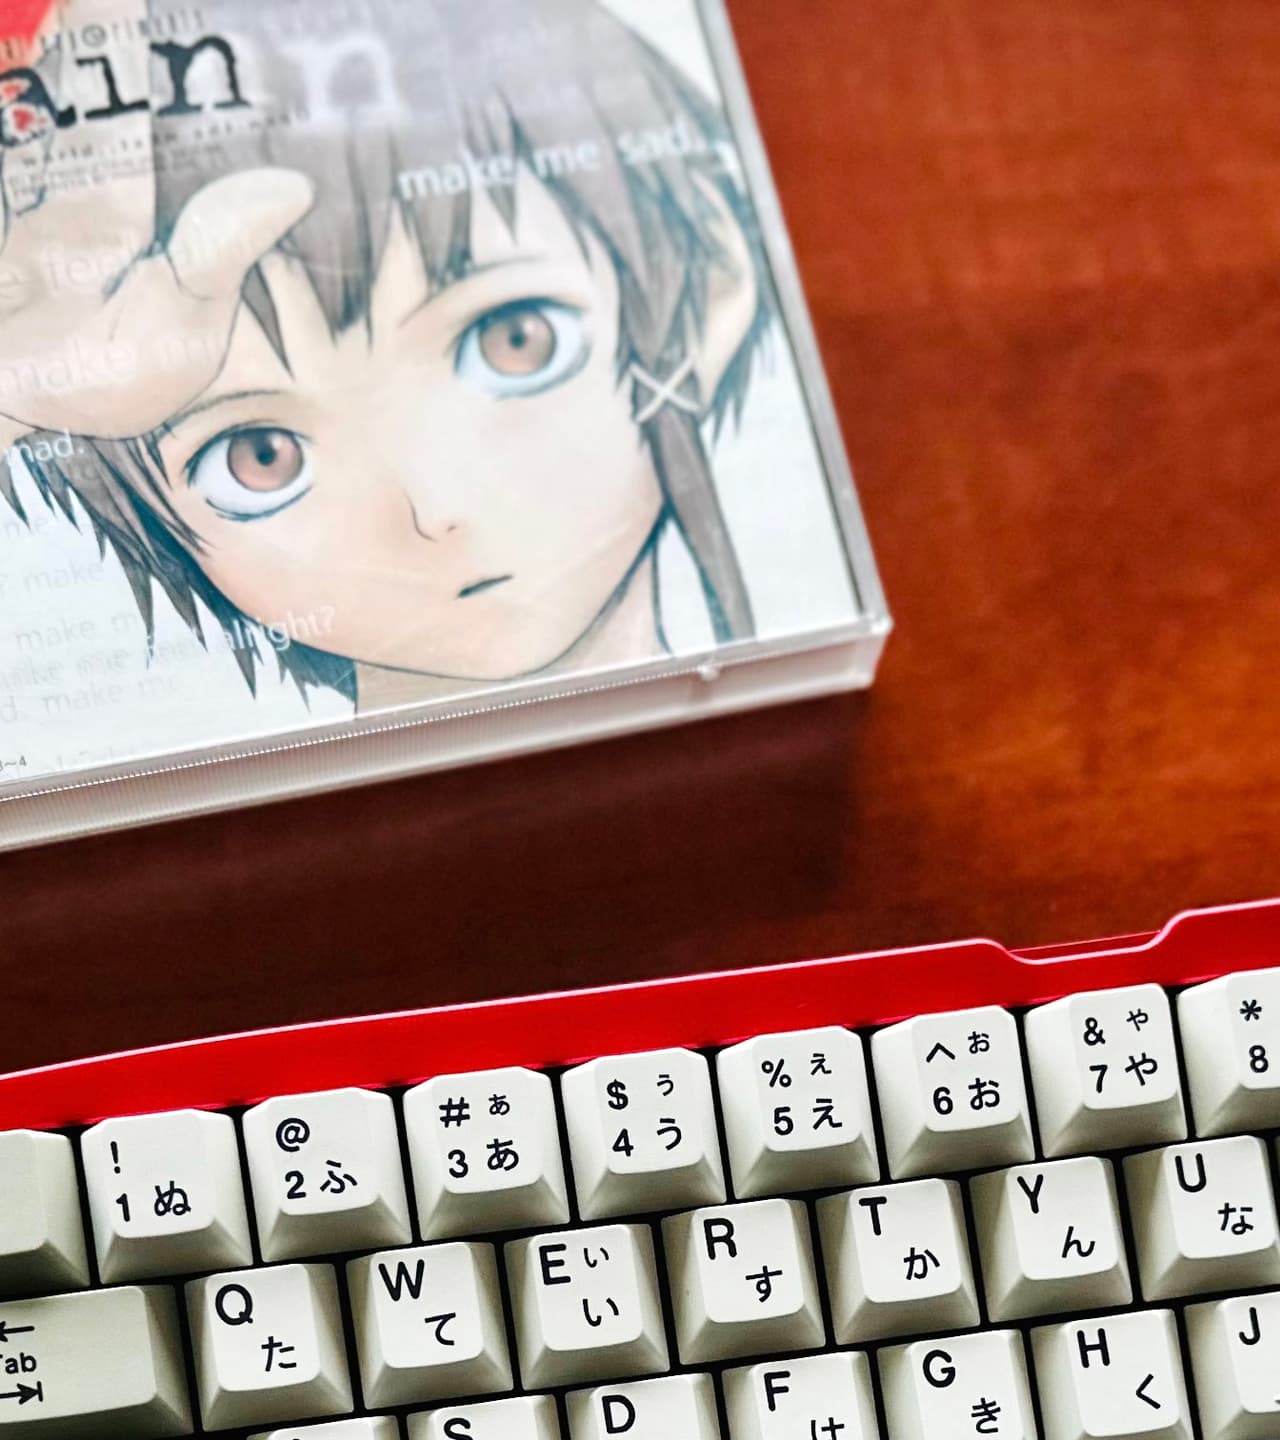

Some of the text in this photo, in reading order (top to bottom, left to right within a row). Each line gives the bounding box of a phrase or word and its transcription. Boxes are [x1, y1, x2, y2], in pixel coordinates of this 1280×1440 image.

[397, 148, 515, 199] make
[533, 142, 601, 177] me
[6, 428, 85, 464] mad.
[222, 605, 336, 653] alright?
[1083, 1017, 1106, 1047] &
[761, 1058, 793, 1088] %
[1089, 1052, 1158, 1094] 7 や
[1248, 1044, 1269, 1074] 8
[438, 1096, 471, 1129] #
[606, 1078, 629, 1111] $
[932, 1077, 1001, 1116] 6 お
[275, 1117, 311, 1153] @
[612, 1117, 682, 1157] 4 う
[773, 1098, 843, 1136] 5 え
[447, 1138, 520, 1179] 3 あ
[1174, 1152, 1207, 1193] U
[284, 1159, 358, 1200] 2 ふ
[1016, 1173, 1044, 1215] Y
[115, 1180, 192, 1223] 1 ぬ
[858, 1195, 888, 1236] T
[1217, 1202, 1254, 1236] な
[703, 1217, 738, 1261] R
[1061, 1225, 1096, 1259] ん
[377, 1258, 425, 1302] W
[538, 1243, 572, 1286] E
[903, 1246, 941, 1281] か
[745, 1265, 783, 1303] す
[214, 1283, 254, 1326] Q
[582, 1297, 620, 1328] い
[424, 1311, 457, 1346] て
[1238, 1306, 1261, 1346] J
[260, 1335, 297, 1373] た
[1076, 1327, 1111, 1369] H
[922, 1349, 956, 1389] G
[763, 1370, 791, 1412] F
[1135, 1373, 1161, 1410] く
[601, 1394, 636, 1435] D
[970, 1397, 1001, 1434] き
